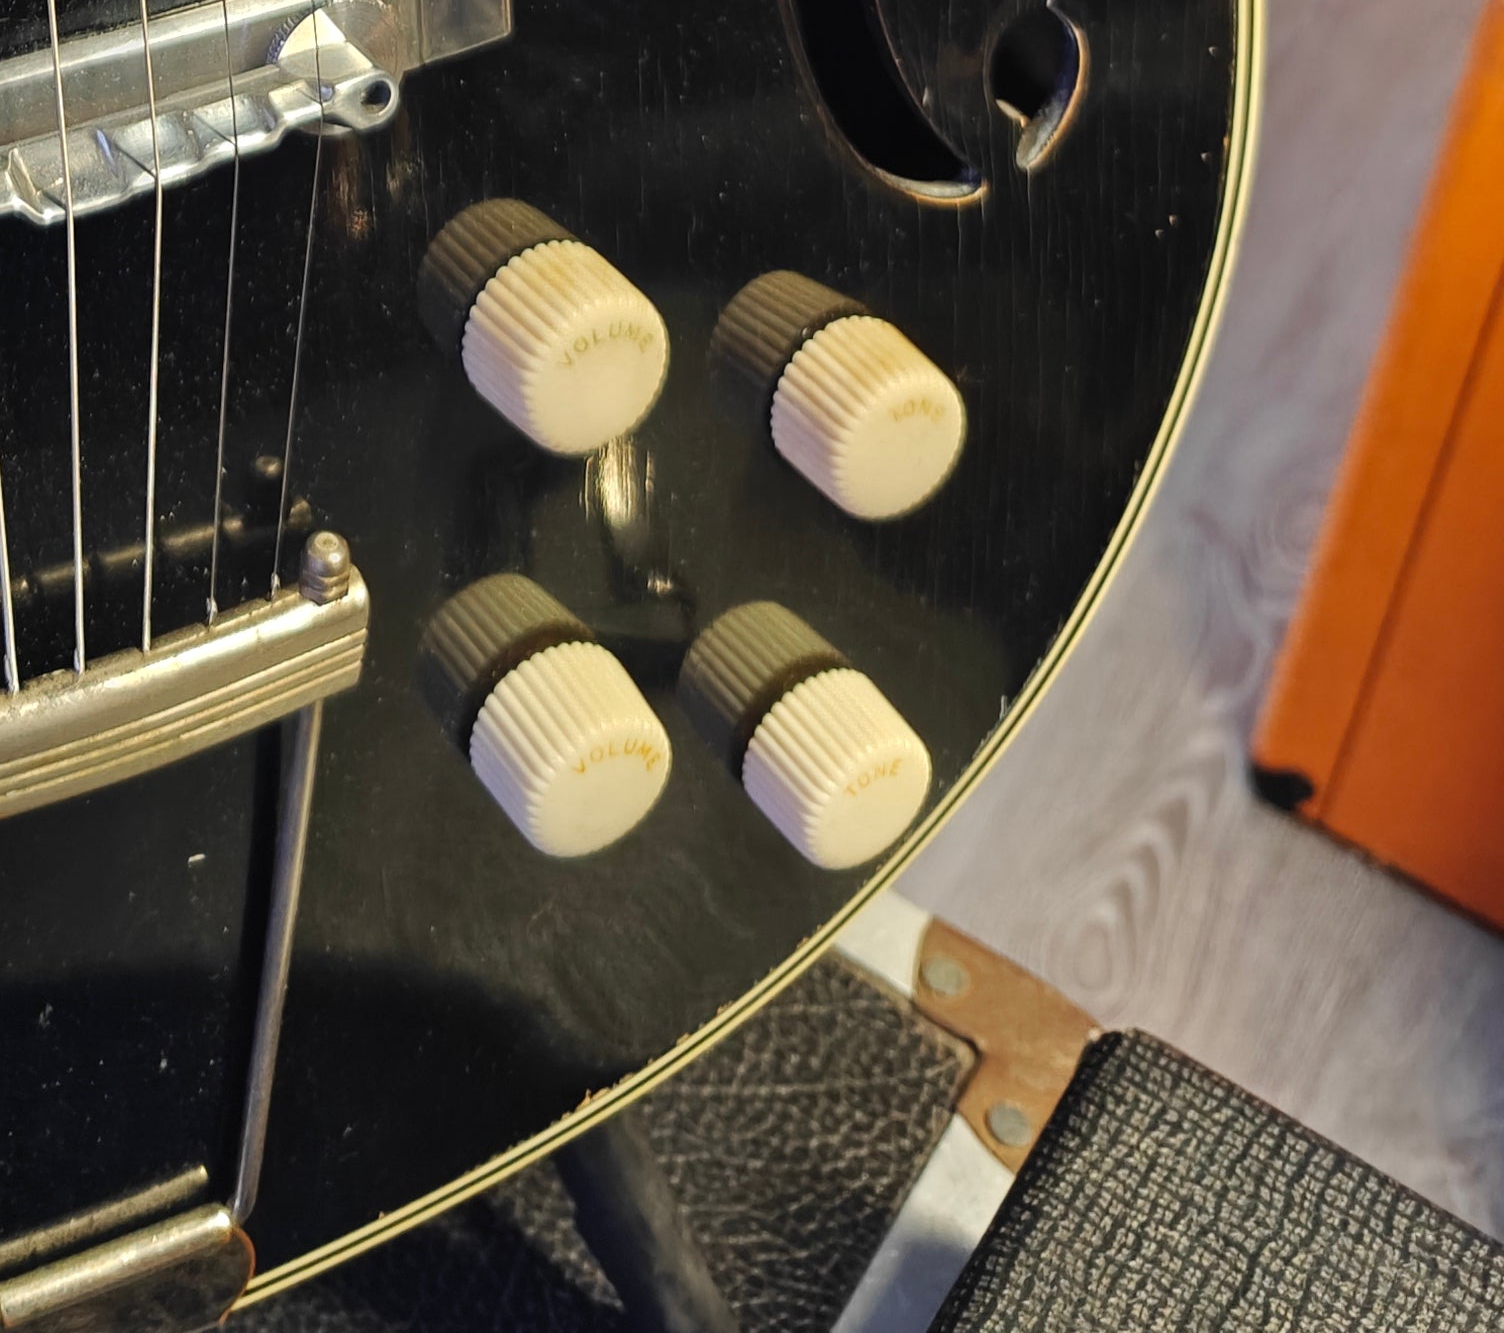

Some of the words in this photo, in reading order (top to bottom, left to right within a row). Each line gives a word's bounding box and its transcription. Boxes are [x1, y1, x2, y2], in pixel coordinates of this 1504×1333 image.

[559, 321, 654, 367] VOLUME
[889, 397, 945, 424] TONE
[571, 738, 661, 774] VOLUME
[843, 757, 902, 797] TONE
